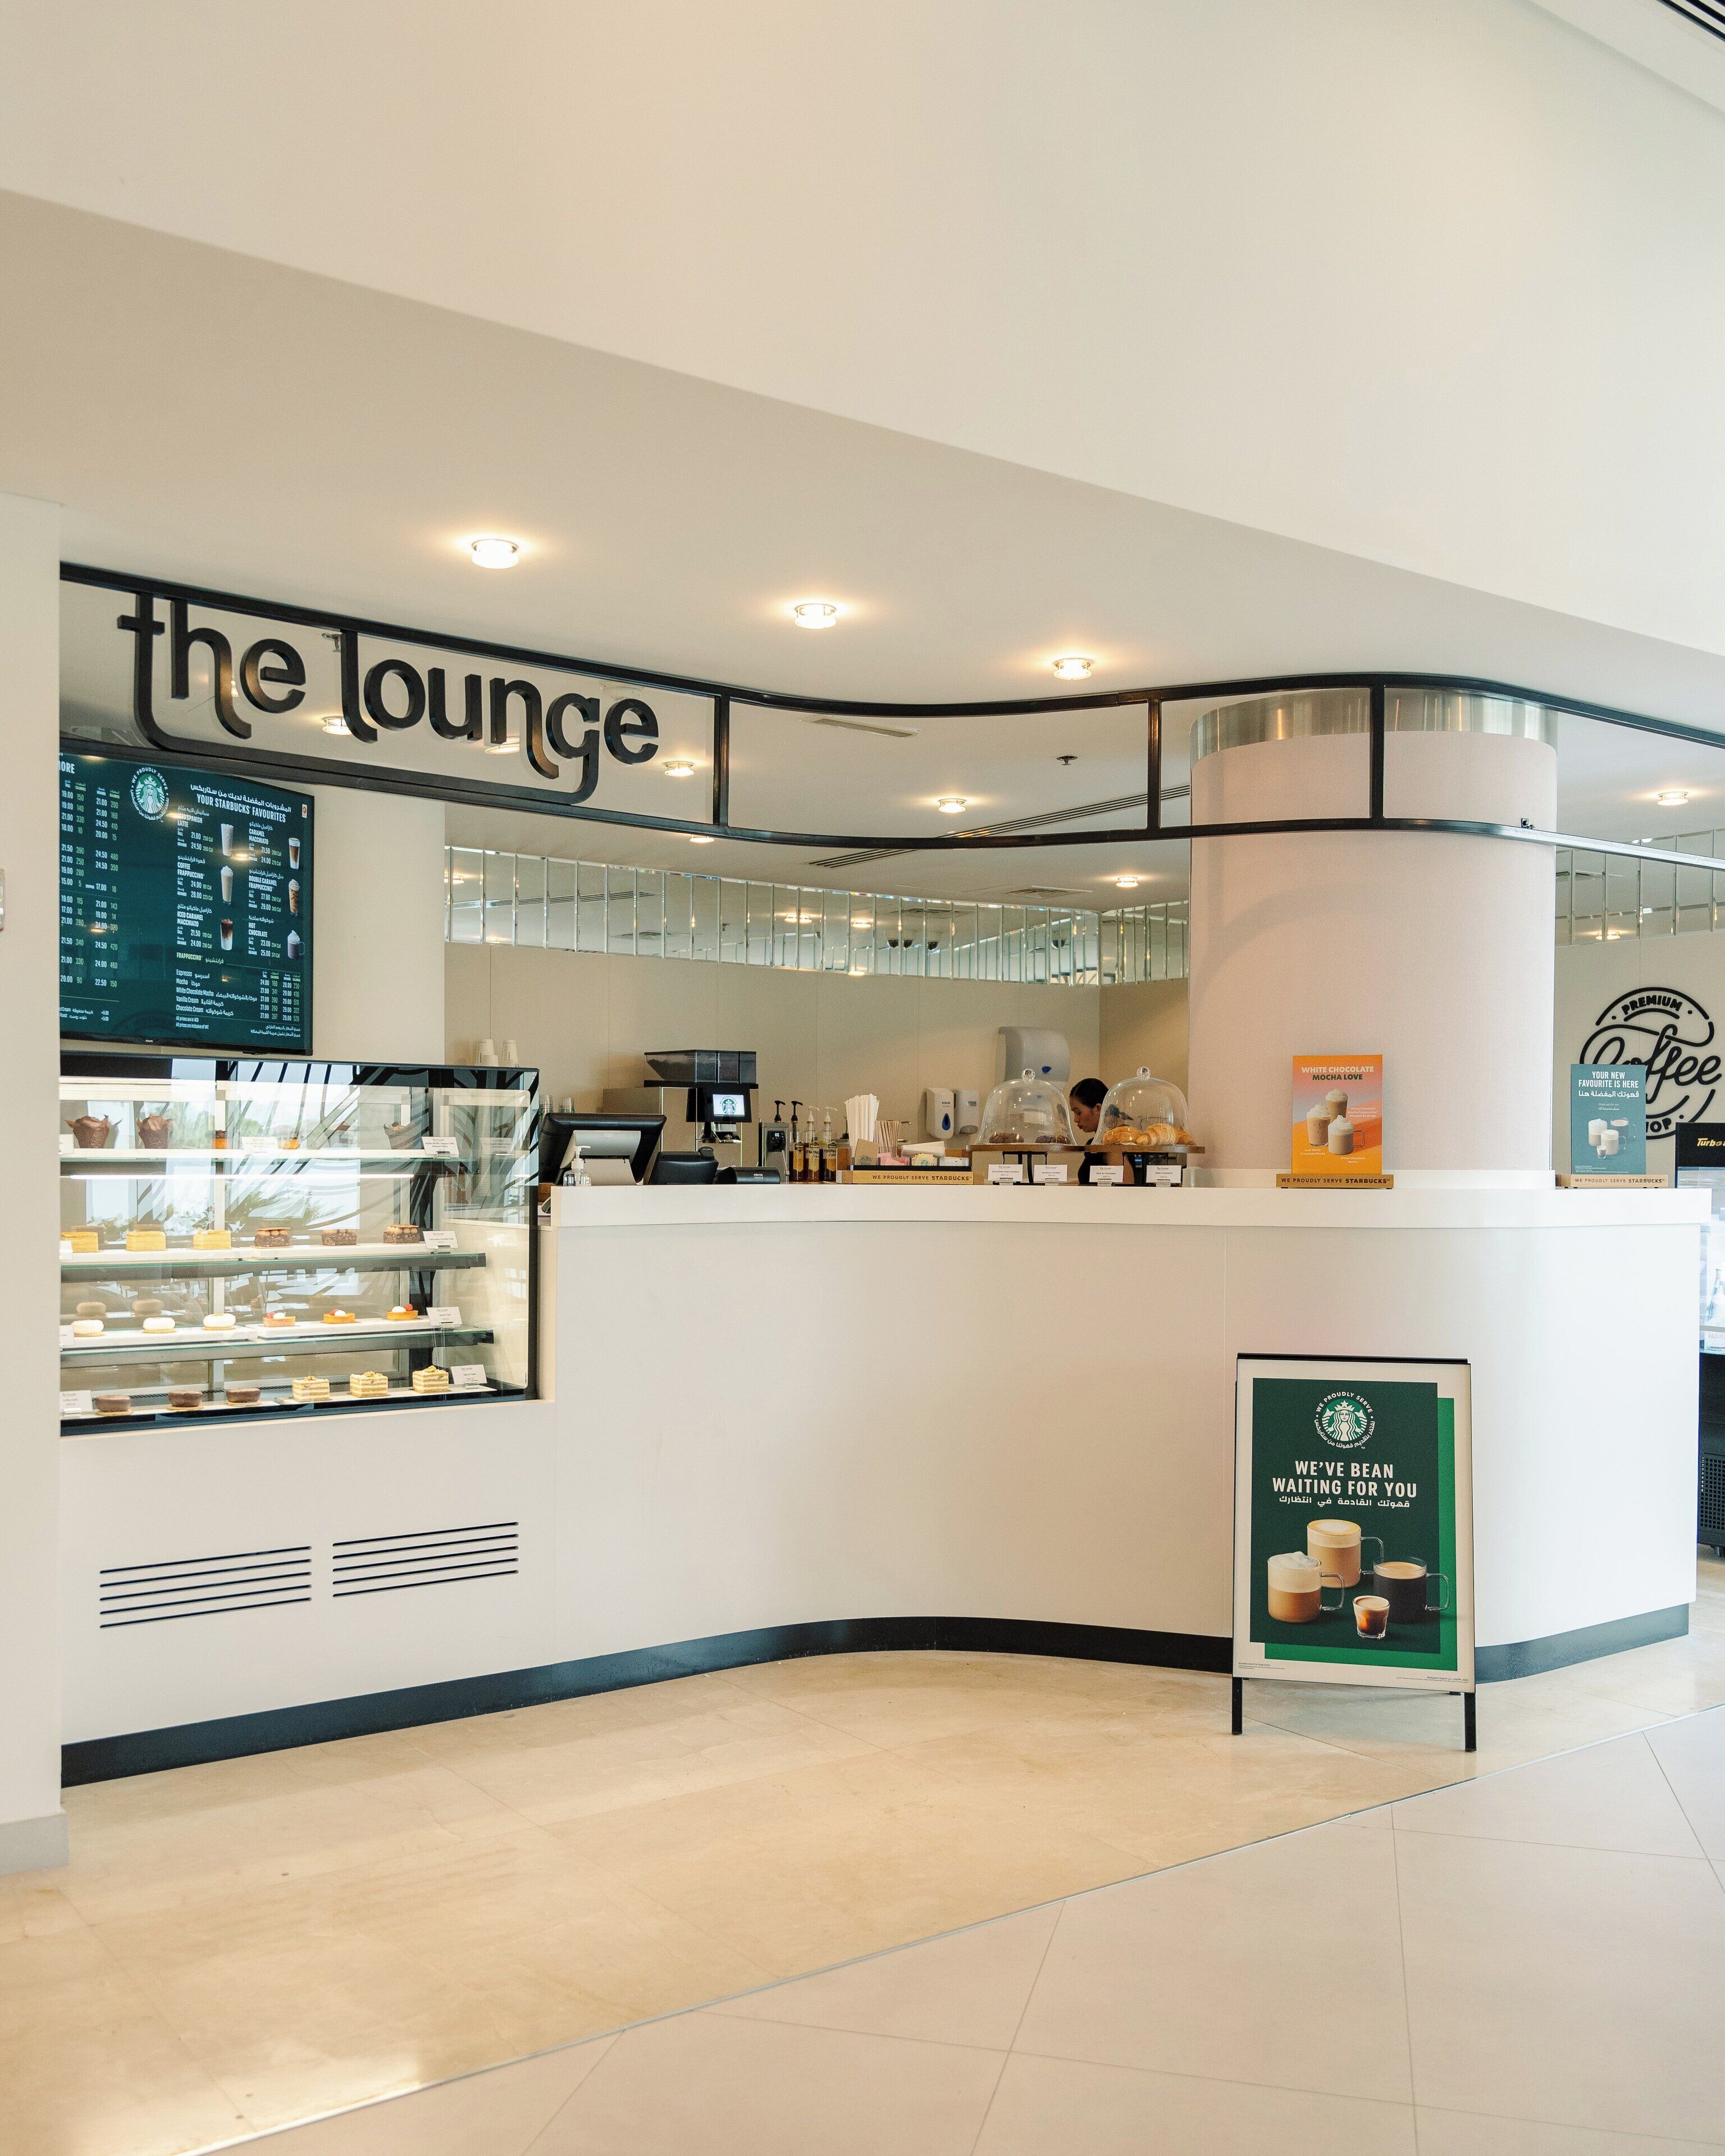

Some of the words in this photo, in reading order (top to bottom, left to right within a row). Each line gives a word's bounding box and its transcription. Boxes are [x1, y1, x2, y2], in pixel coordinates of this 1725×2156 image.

[117, 592, 307, 749] the
[340, 629, 659, 806] lounge
[60, 761, 75, 774] ORE
[131, 775, 138, 784] WE
[136, 767, 157, 776] PROUDLY
[157, 773, 168, 790] SERVE
[190, 784, 217, 795] ستاربكس
[218, 789, 226, 798] من
[243, 795, 264, 806] المفضلة
[197, 793, 213, 807] YOUR
[252, 806, 286, 823] FAVOURITES
[265, 802, 291, 812] المشروبات
[191, 832, 201, 840] 21.00
[249, 828, 265, 837] CARAMEL
[249, 835, 269, 845] MACCHIATO
[191, 842, 202, 851] 24.50
[191, 880, 202, 889] 24.00
[262, 878, 277, 886] CARAMEL
[186, 912, 204, 921] CARAMEL
[177, 918, 199, 927] MACCHIATO
[248, 929, 268, 938] CHOCOLATE
[1621, 994, 1683, 1016] PREMIUM
[1579, 1023, 1722, 1104] Cffee
[1592, 1071, 1609, 1079] YOUR
[1578, 1079, 1613, 1088] FAVOURITE
[1614, 1080, 1621, 1088] IS
[1316, 1403, 1324, 1412] WE
[1324, 1391, 1354, 1403] PROUDLY
[1356, 1395, 1373, 1413] SERVE
[1314, 1419, 1328, 1441] ستاربكس
[1295, 1460, 1344, 1478] WE'VE
[1350, 1460, 1394, 1479] BEAN
[1272, 1477, 1341, 1495] WAITING
[1348, 1478, 1379, 1496] FOR
[1385, 1481, 1417, 1498] YOU
[1279, 1495, 1312, 1505] انتظارك
[1317, 1496, 1332, 1507] في
[1338, 1496, 1372, 1508] القادمة
[1378, 1498, 1410, 1510] قهوتك
